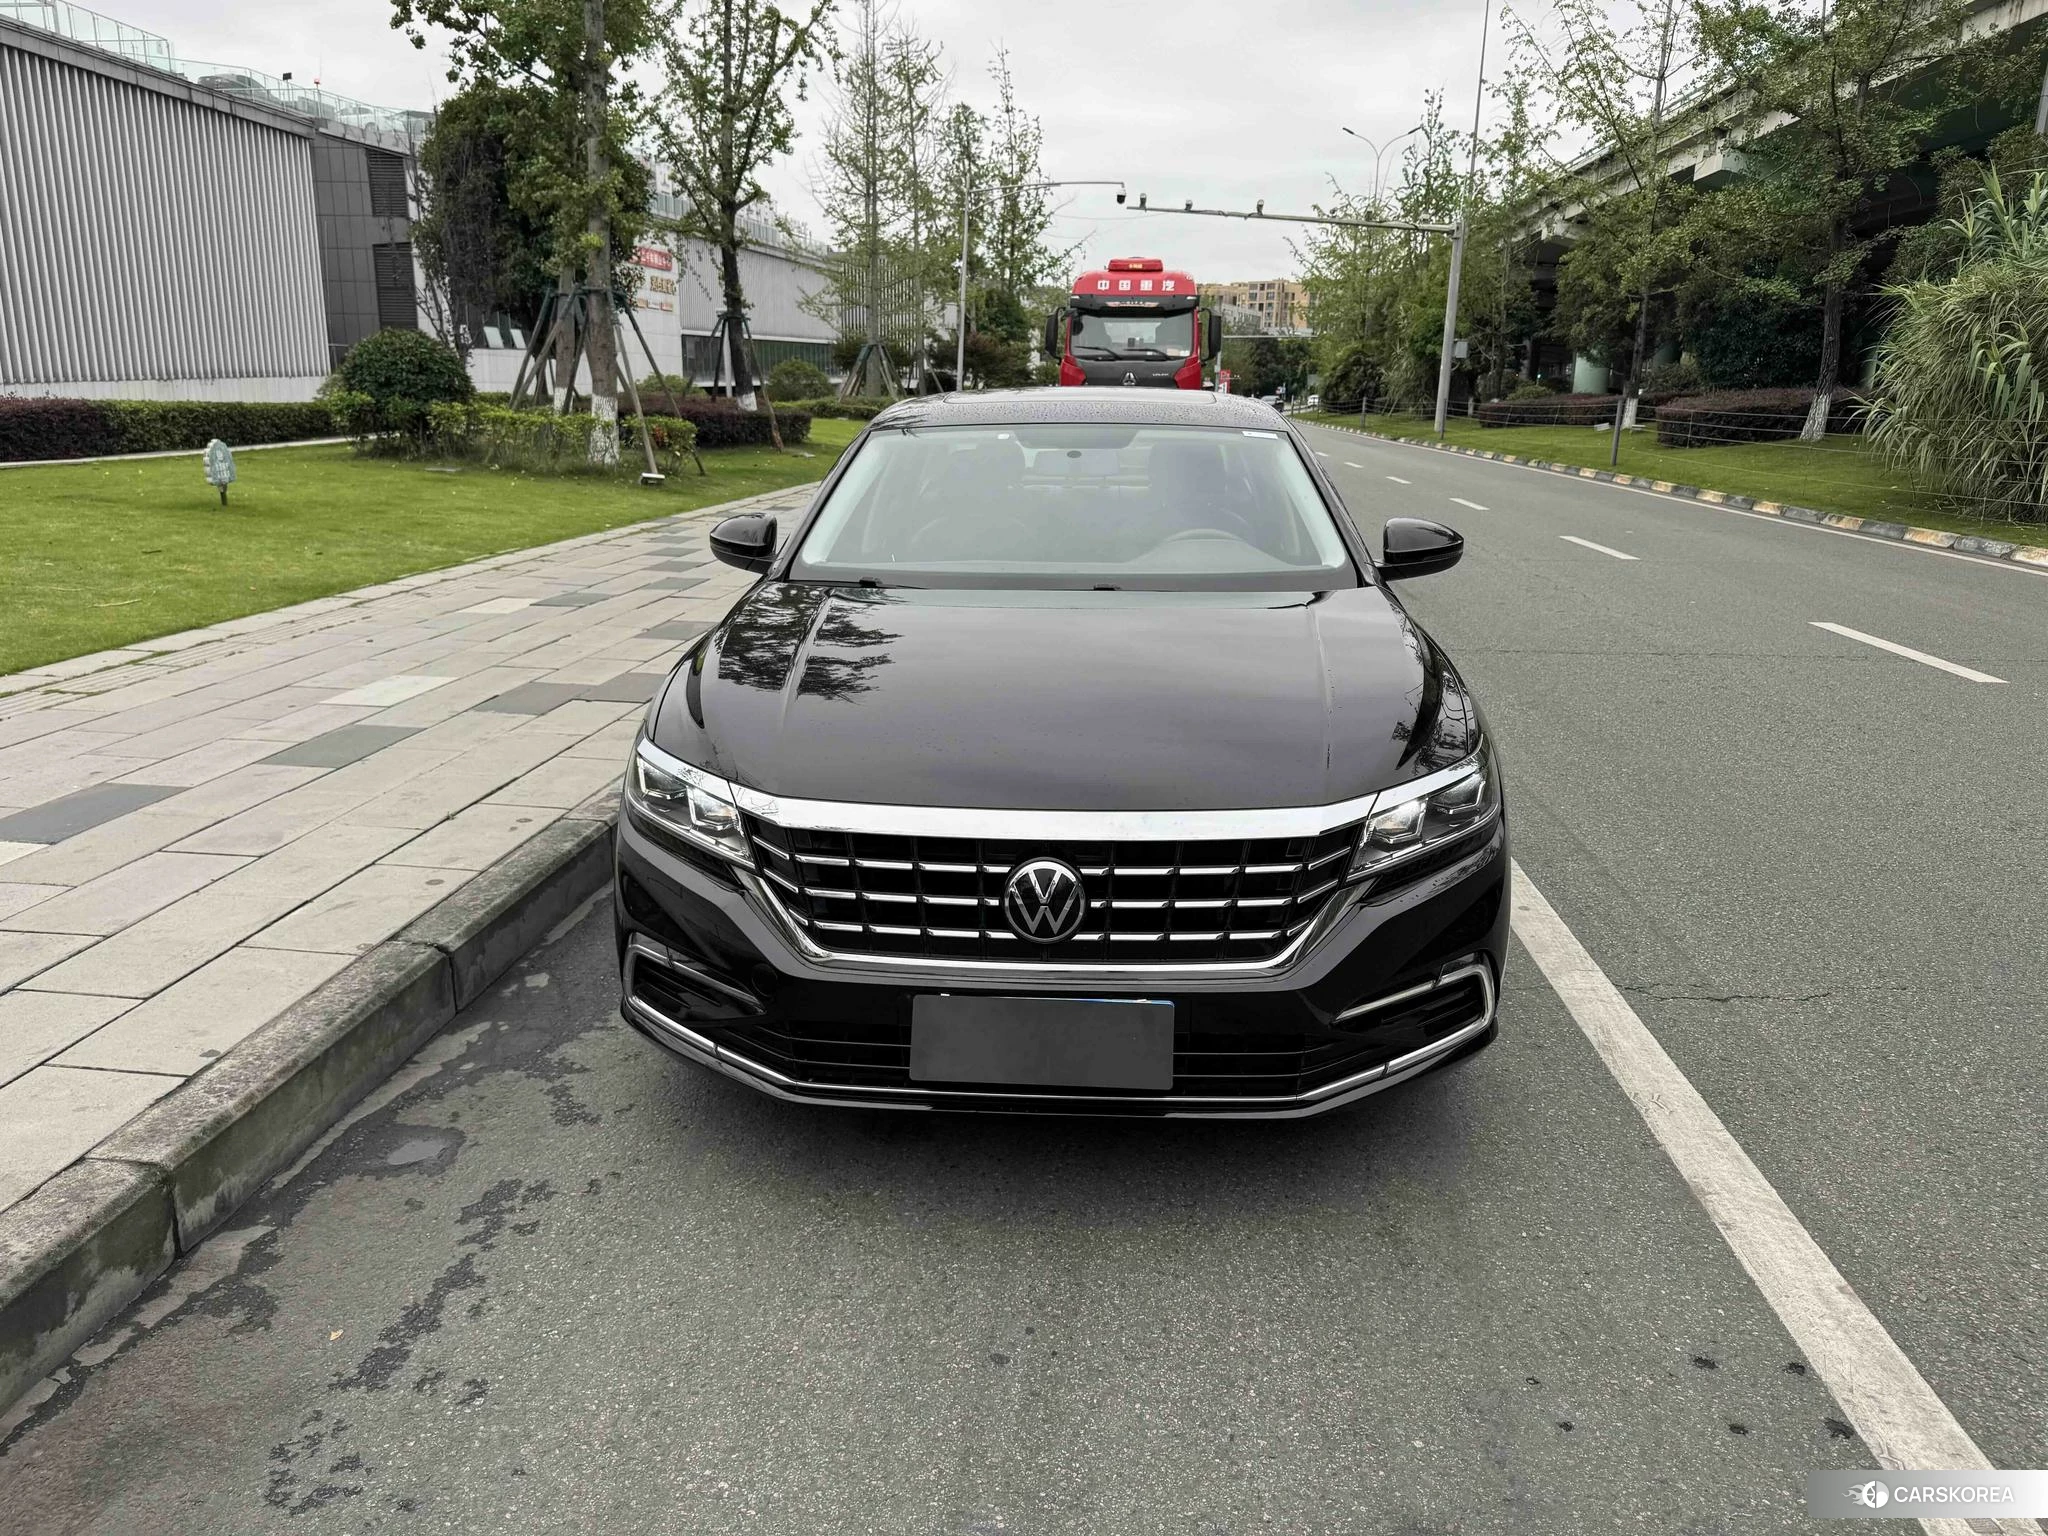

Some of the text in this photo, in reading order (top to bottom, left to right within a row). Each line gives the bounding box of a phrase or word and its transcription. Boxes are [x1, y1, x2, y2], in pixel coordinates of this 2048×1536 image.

[1097, 279, 1175, 292] 中国重汽
[1007, 859, 1082, 940] VW
